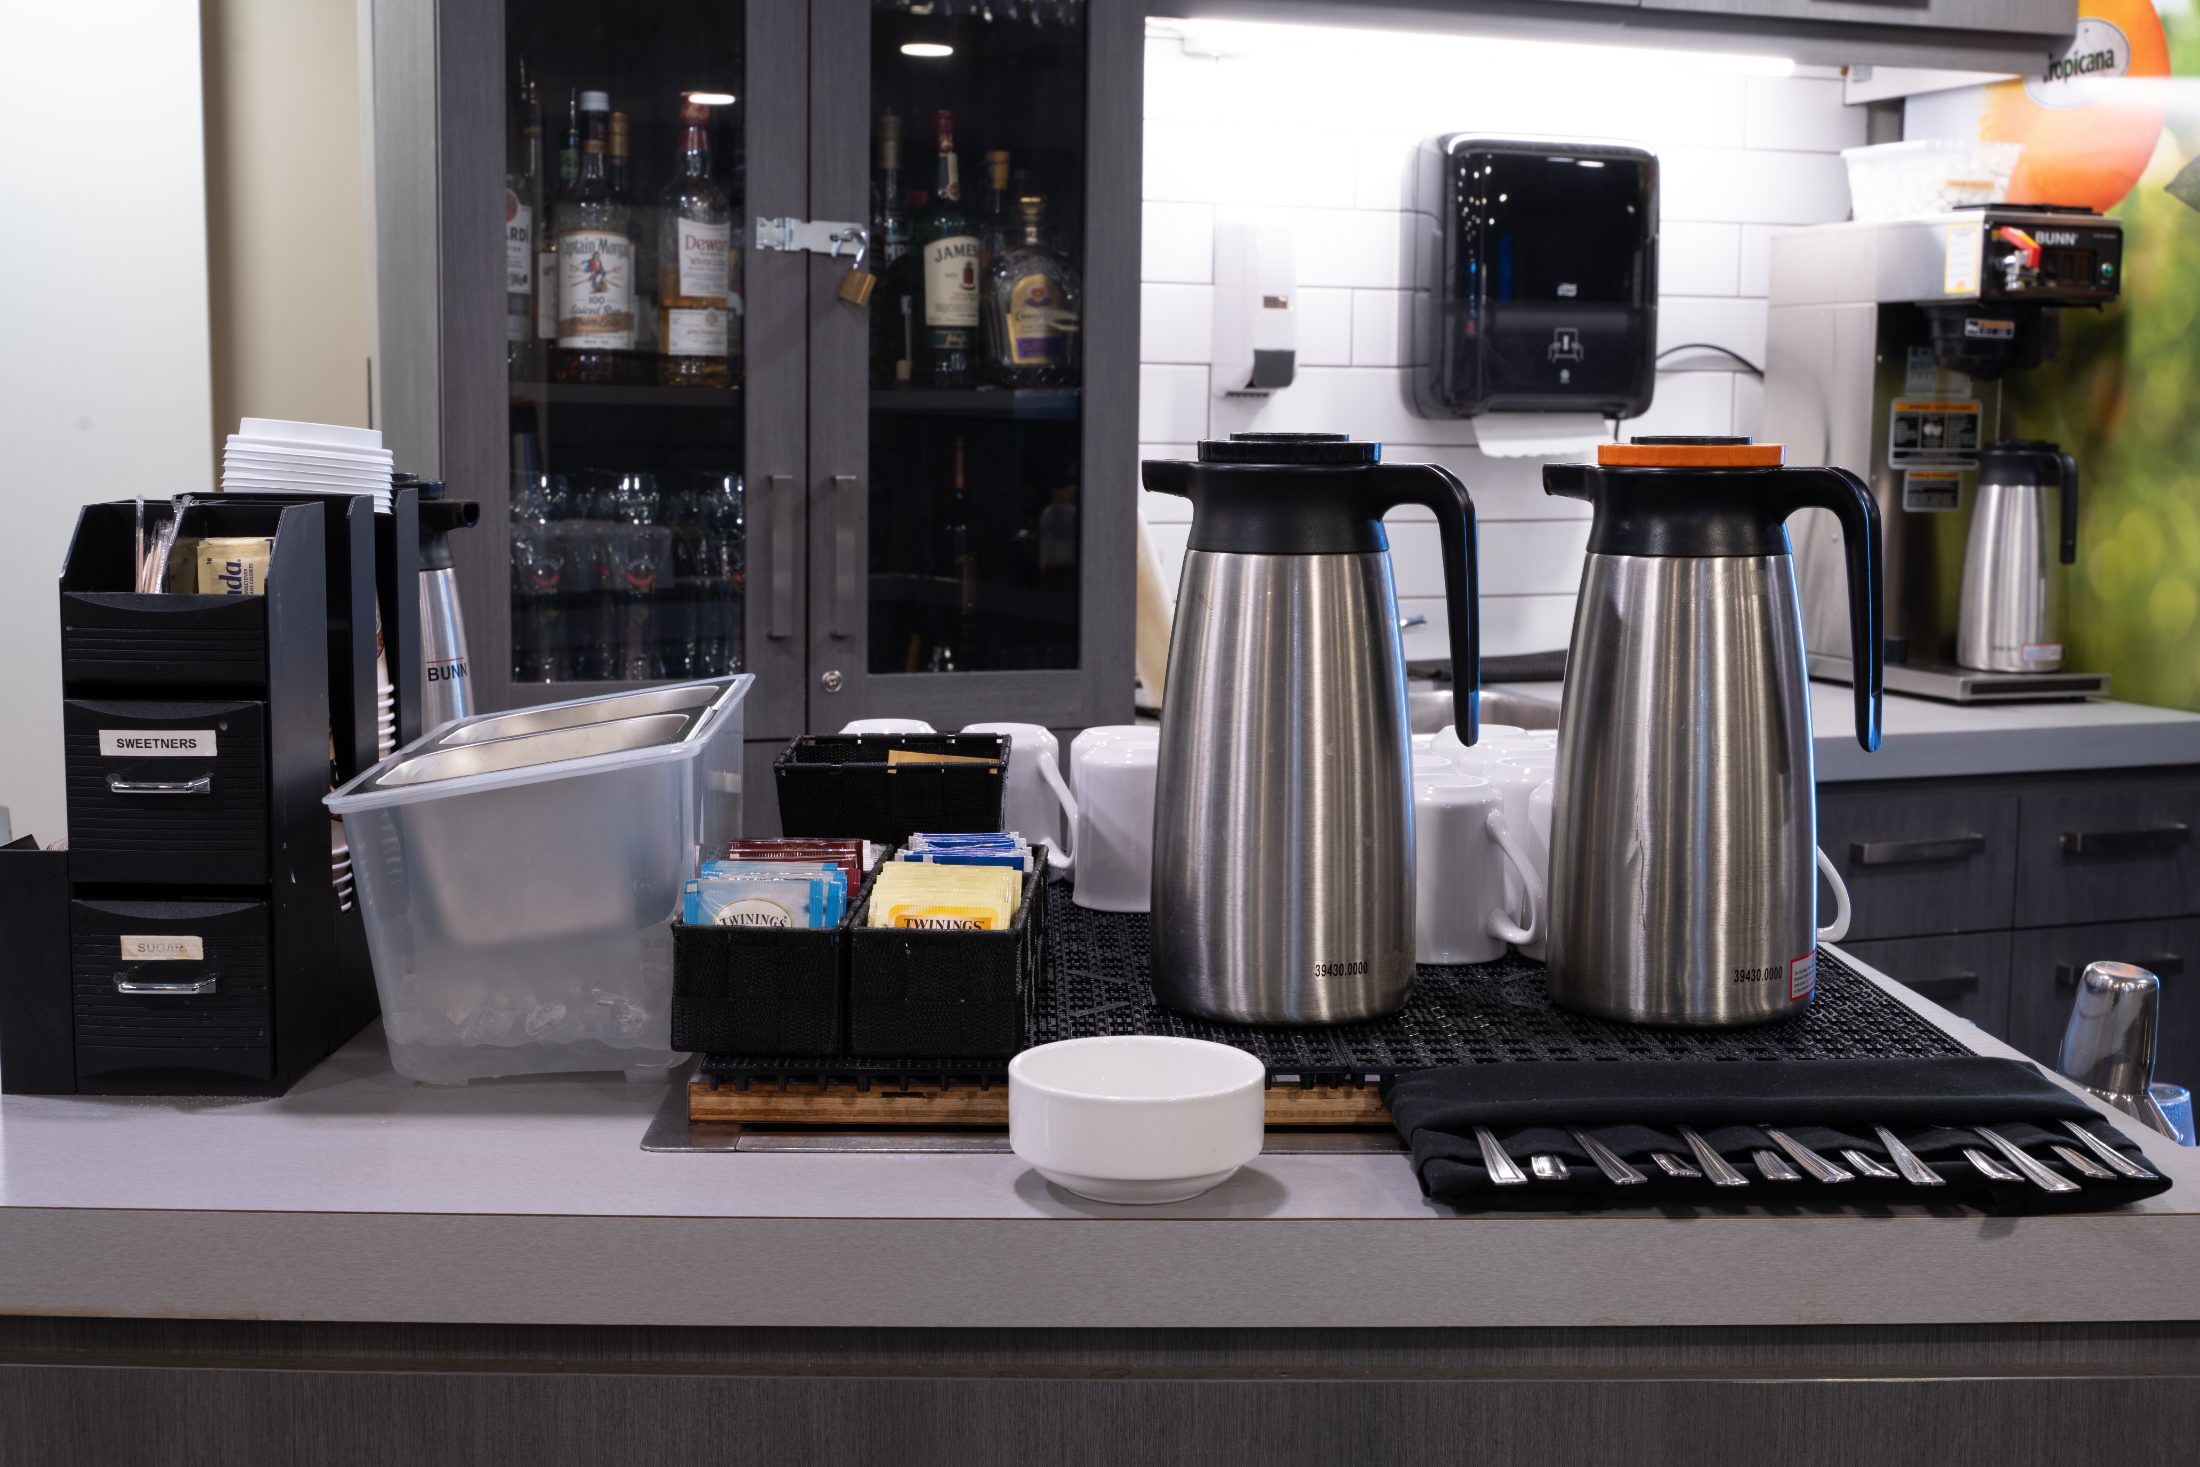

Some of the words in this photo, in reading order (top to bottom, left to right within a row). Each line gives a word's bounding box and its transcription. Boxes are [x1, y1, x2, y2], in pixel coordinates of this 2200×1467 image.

[2043, 48, 2116, 85] ropicana
[2034, 231, 2076, 246] BUNN
[588, 296, 605, 304] 100
[427, 662, 468, 682] BUNN
[116, 738, 197, 749] SWEETNERS
[720, 913, 787, 928] TWININGS
[903, 918, 983, 930] TWININGS
[138, 943, 187, 953] SUGAR
[1315, 961, 1368, 977] 39430.0000
[1734, 966, 1783, 982] 39430.0000
